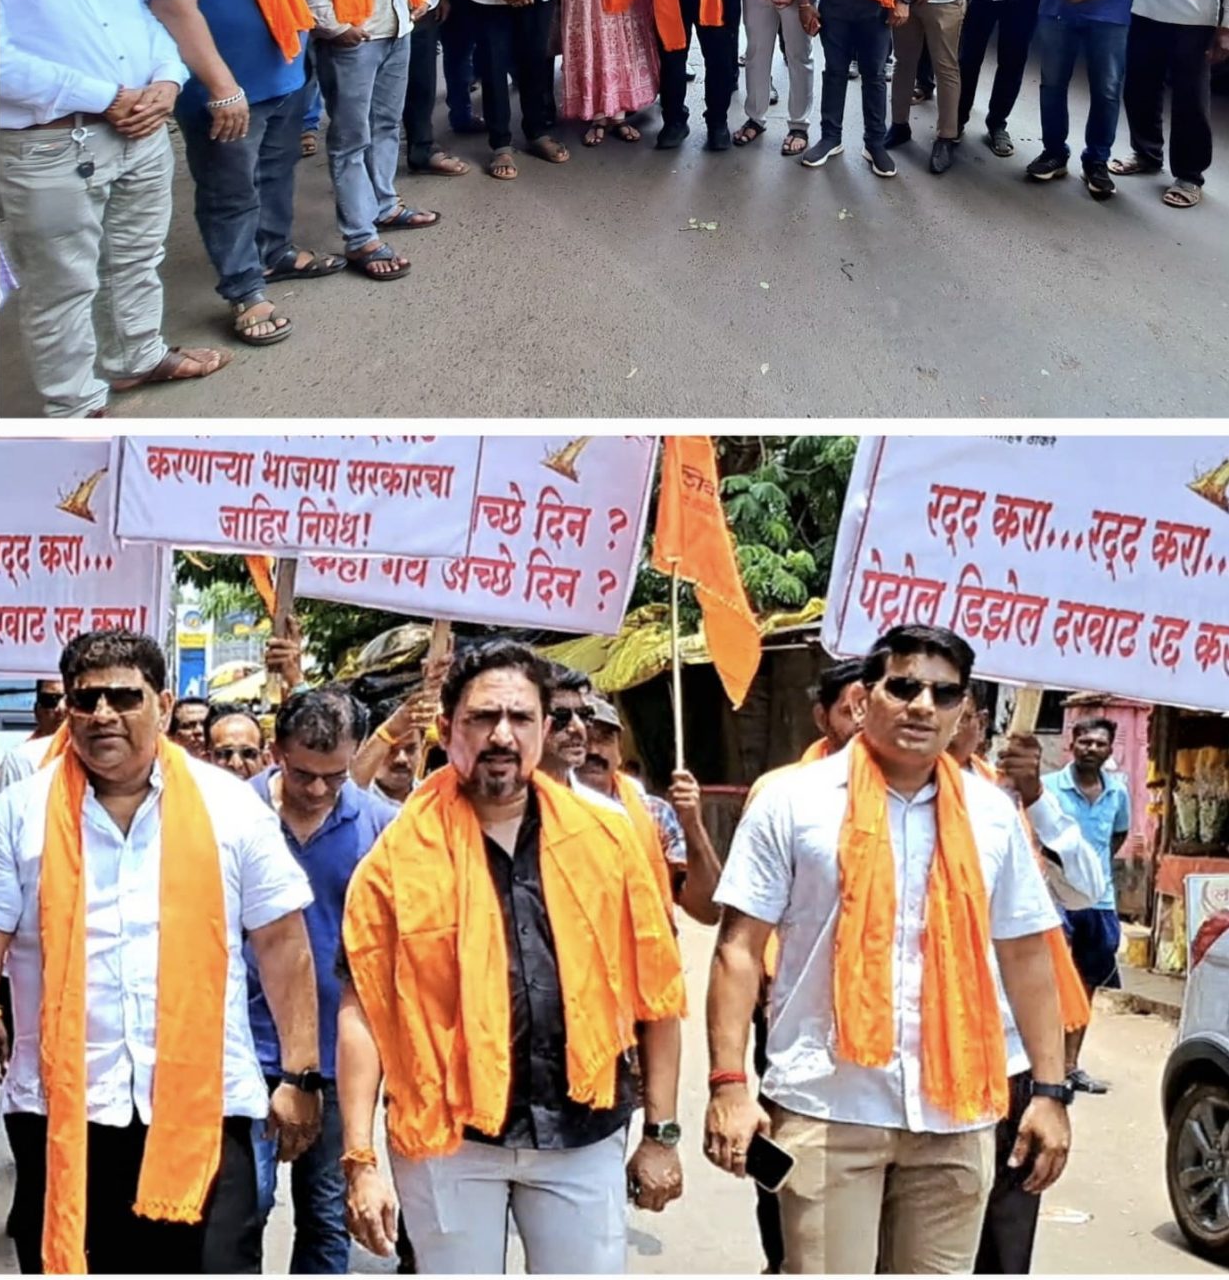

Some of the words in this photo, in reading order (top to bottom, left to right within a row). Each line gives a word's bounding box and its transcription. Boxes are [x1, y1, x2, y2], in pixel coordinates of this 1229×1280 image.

[261, 451, 340, 494] भाजपा
[347, 460, 455, 499] सरकारचा
[219, 493, 289, 546] जाहिर
[533, 485, 592, 550] दिन
[443, 543, 516, 596] अच्छे
[523, 547, 581, 611] दिन
[859, 549, 945, 634] पेट्रोल
[950, 563, 1048, 648] डिझेल
